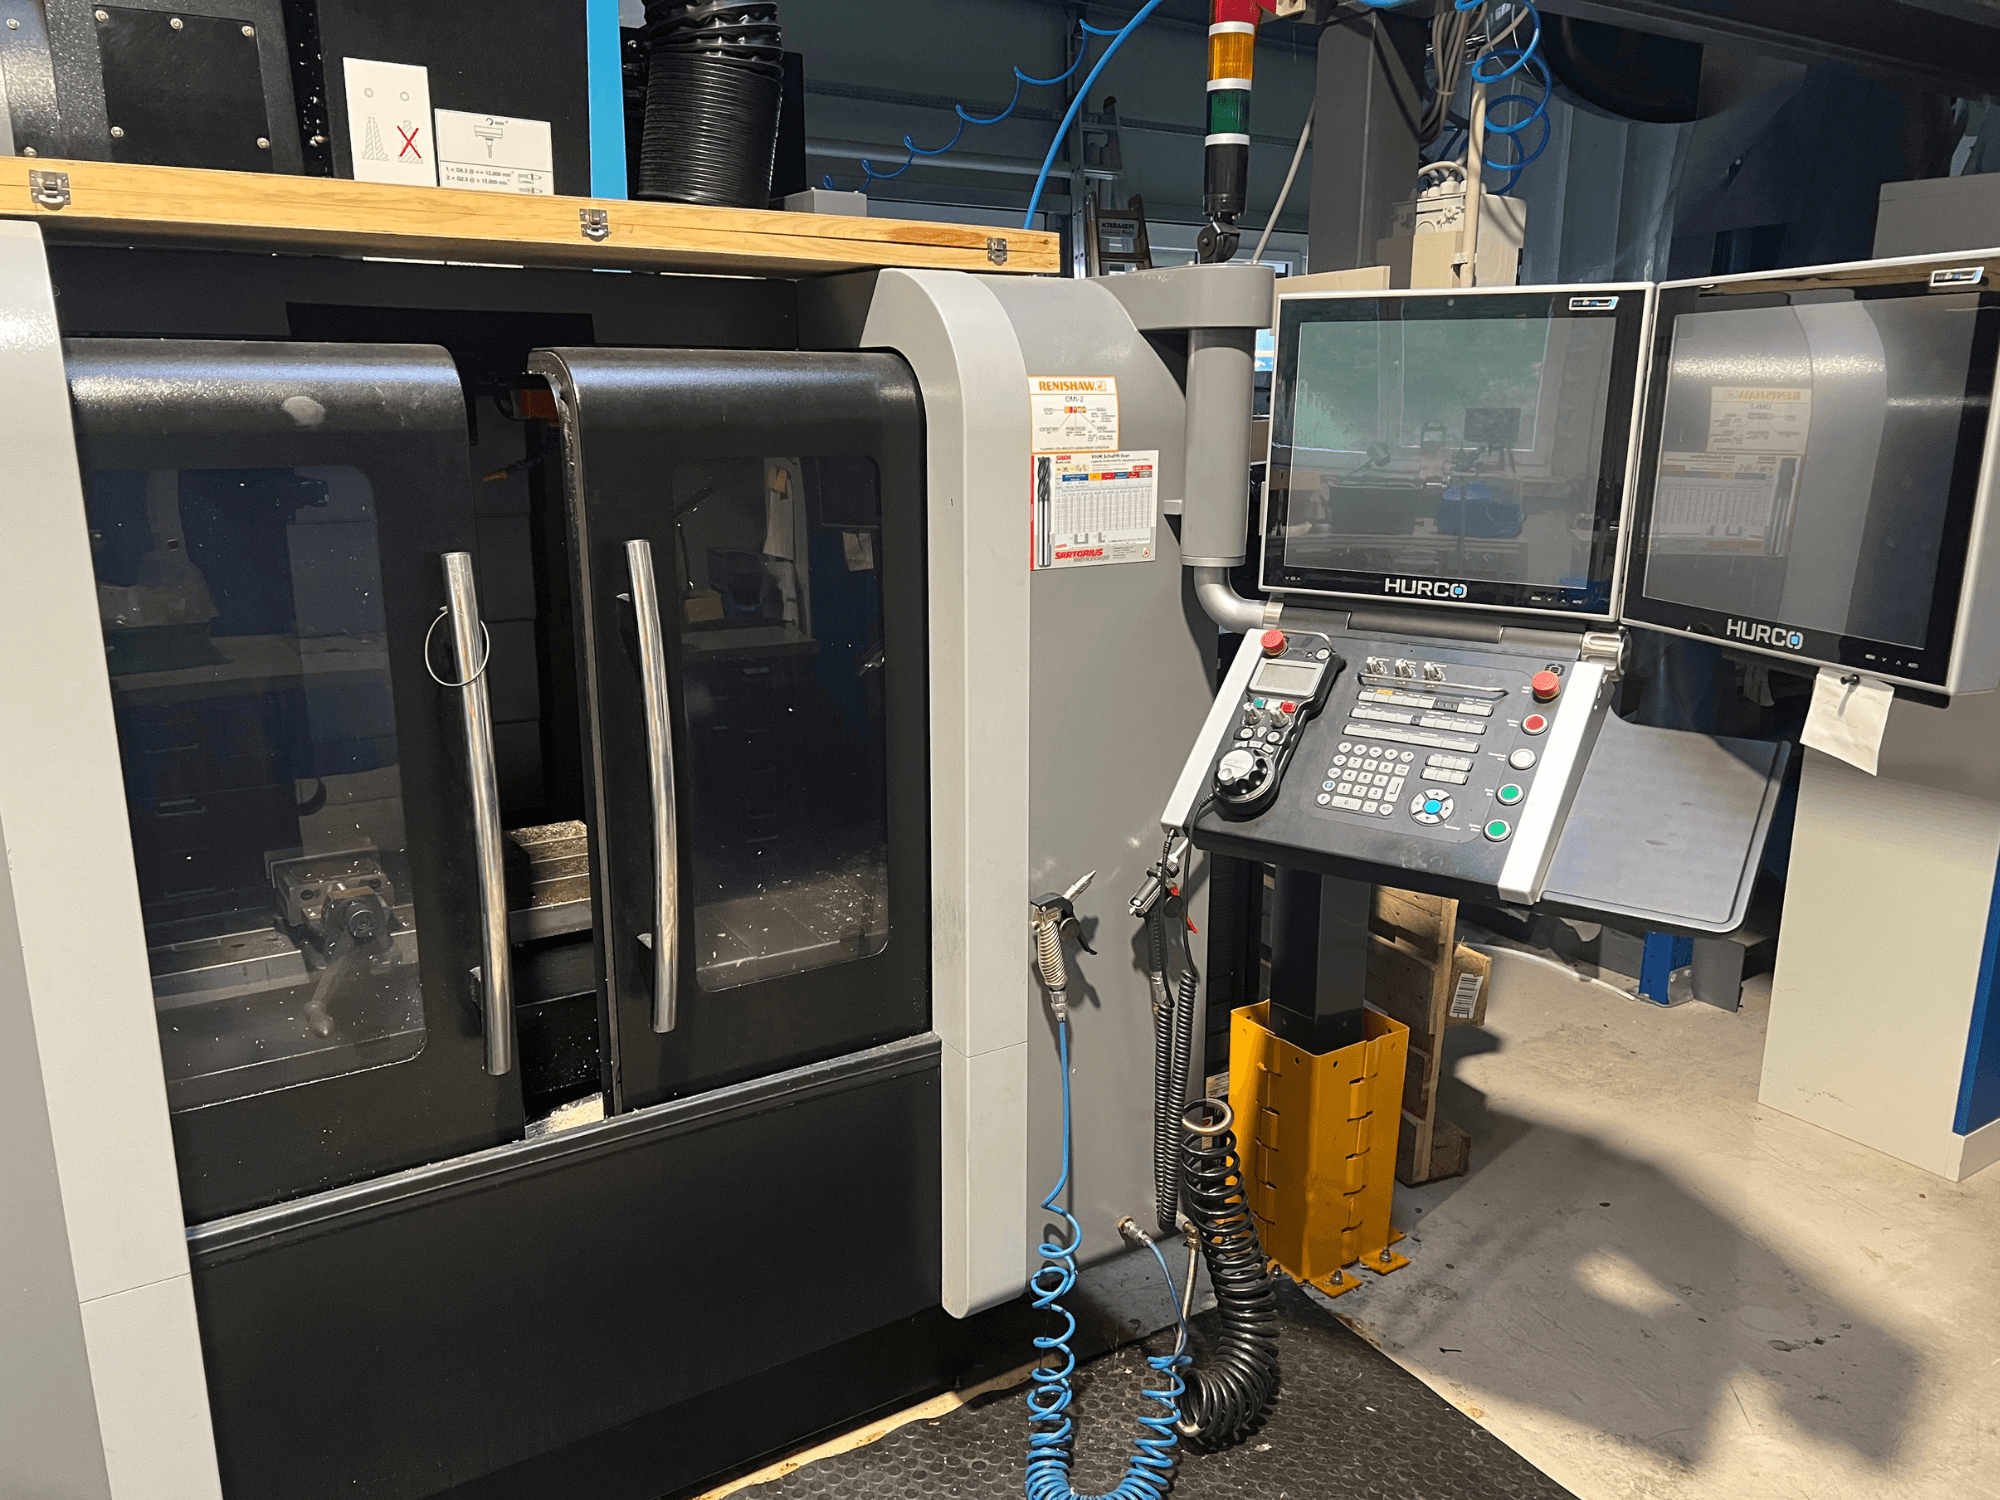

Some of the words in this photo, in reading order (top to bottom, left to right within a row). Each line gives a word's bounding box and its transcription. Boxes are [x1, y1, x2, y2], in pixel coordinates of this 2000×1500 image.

[1055, 548, 1103, 560] SARTORIUS
[1384, 577, 1468, 599] HURCO
[1726, 618, 1804, 650] HURCO
